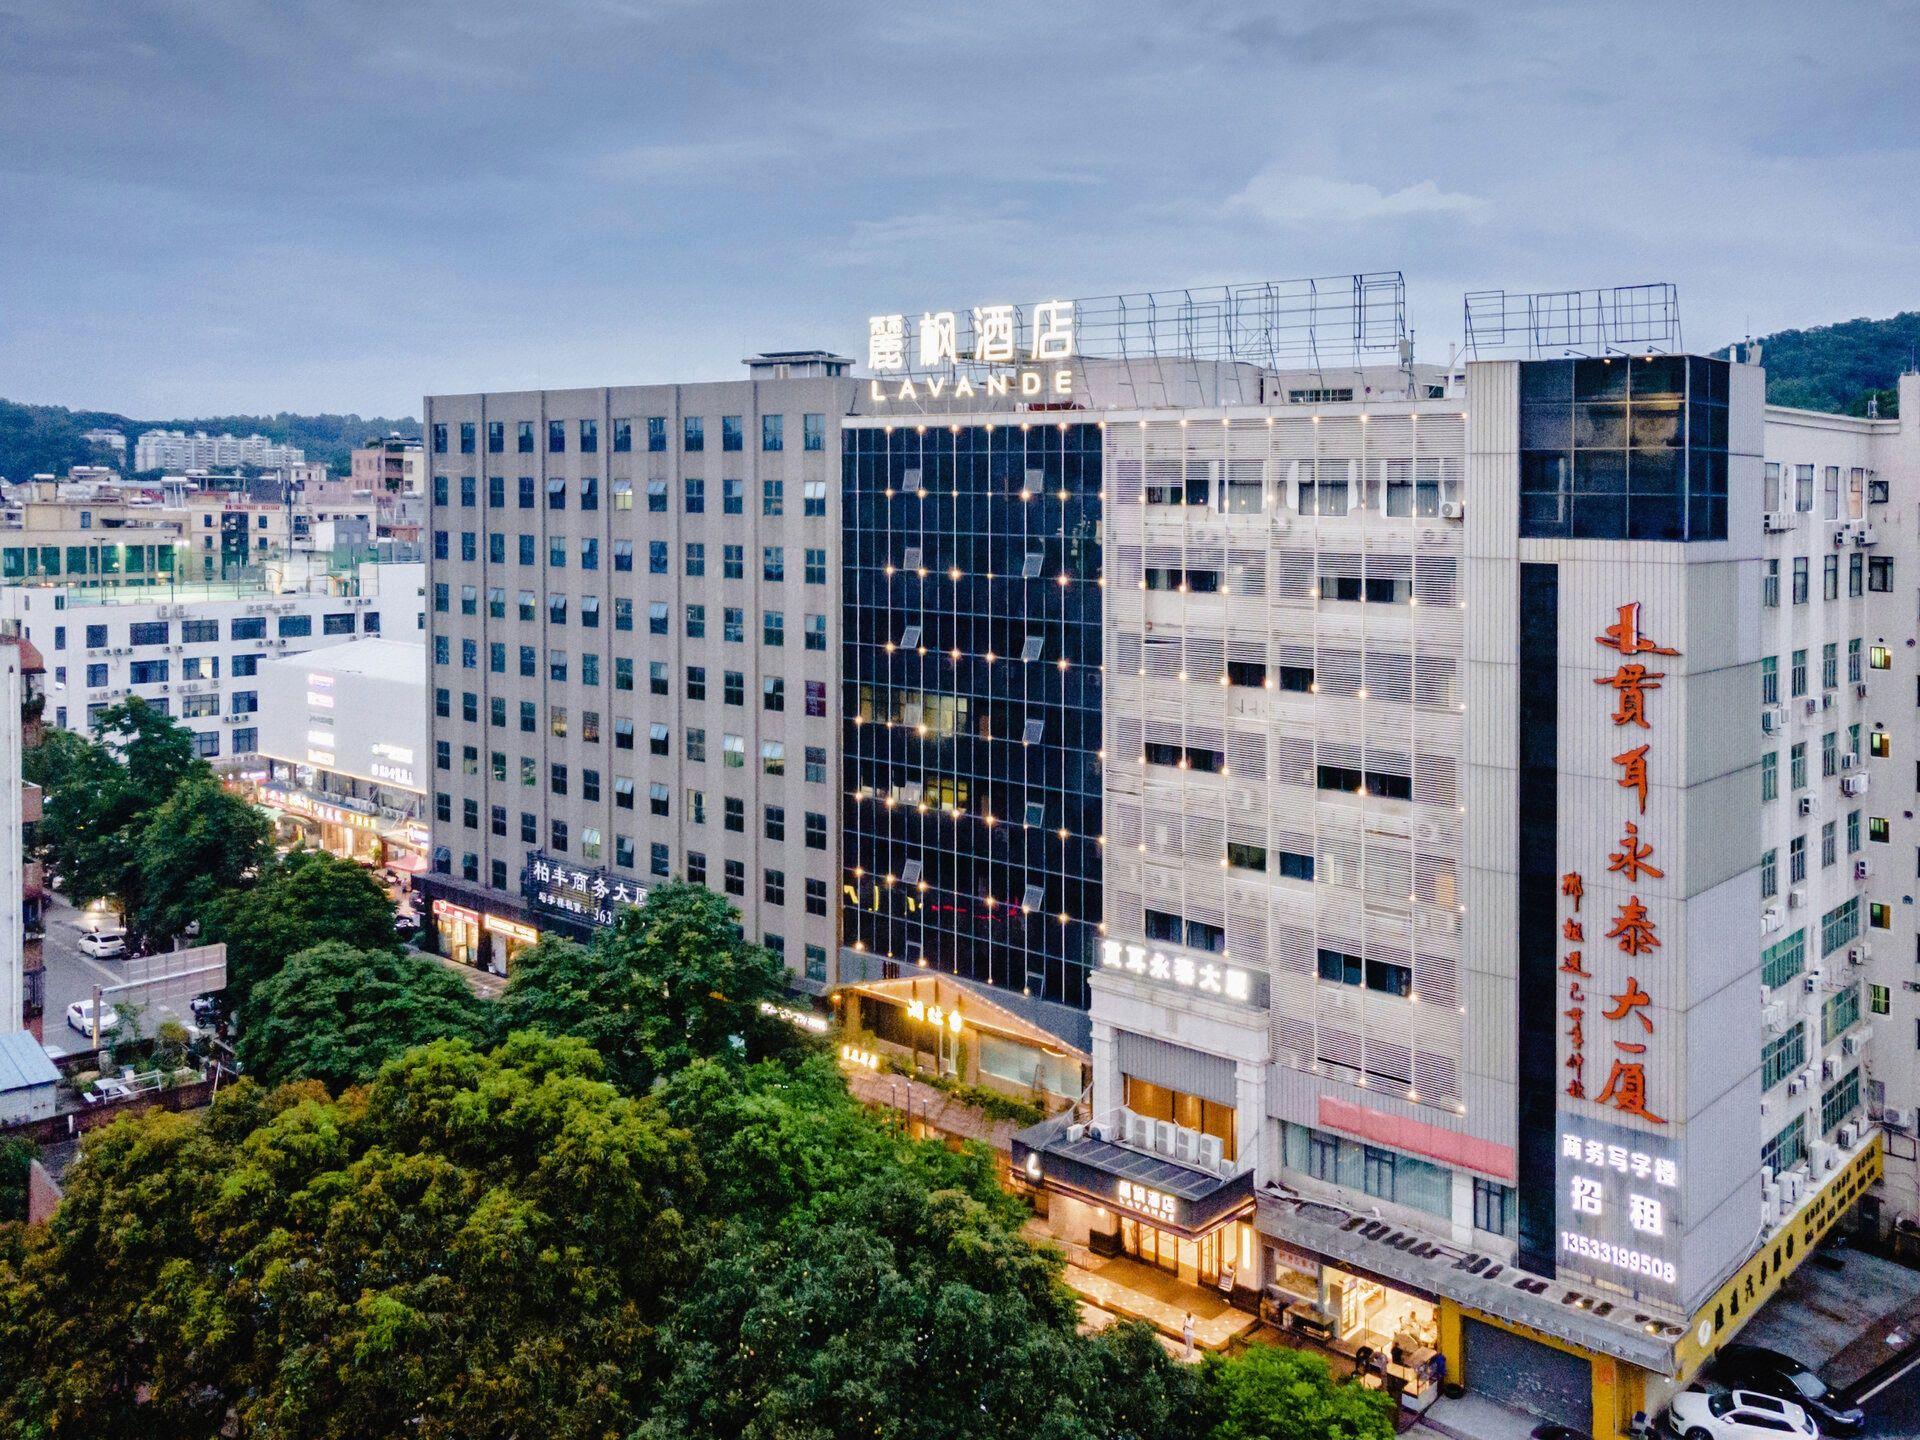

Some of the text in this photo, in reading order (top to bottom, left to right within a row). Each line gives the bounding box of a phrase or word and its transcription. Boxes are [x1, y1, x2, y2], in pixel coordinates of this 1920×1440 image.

[871, 371, 1072, 400] LAVANDE
[1563, 1134, 1677, 1187] 商务写字楼
[1571, 1175, 1664, 1236] 招租
[1562, 1231, 1677, 1283] 13533199508
